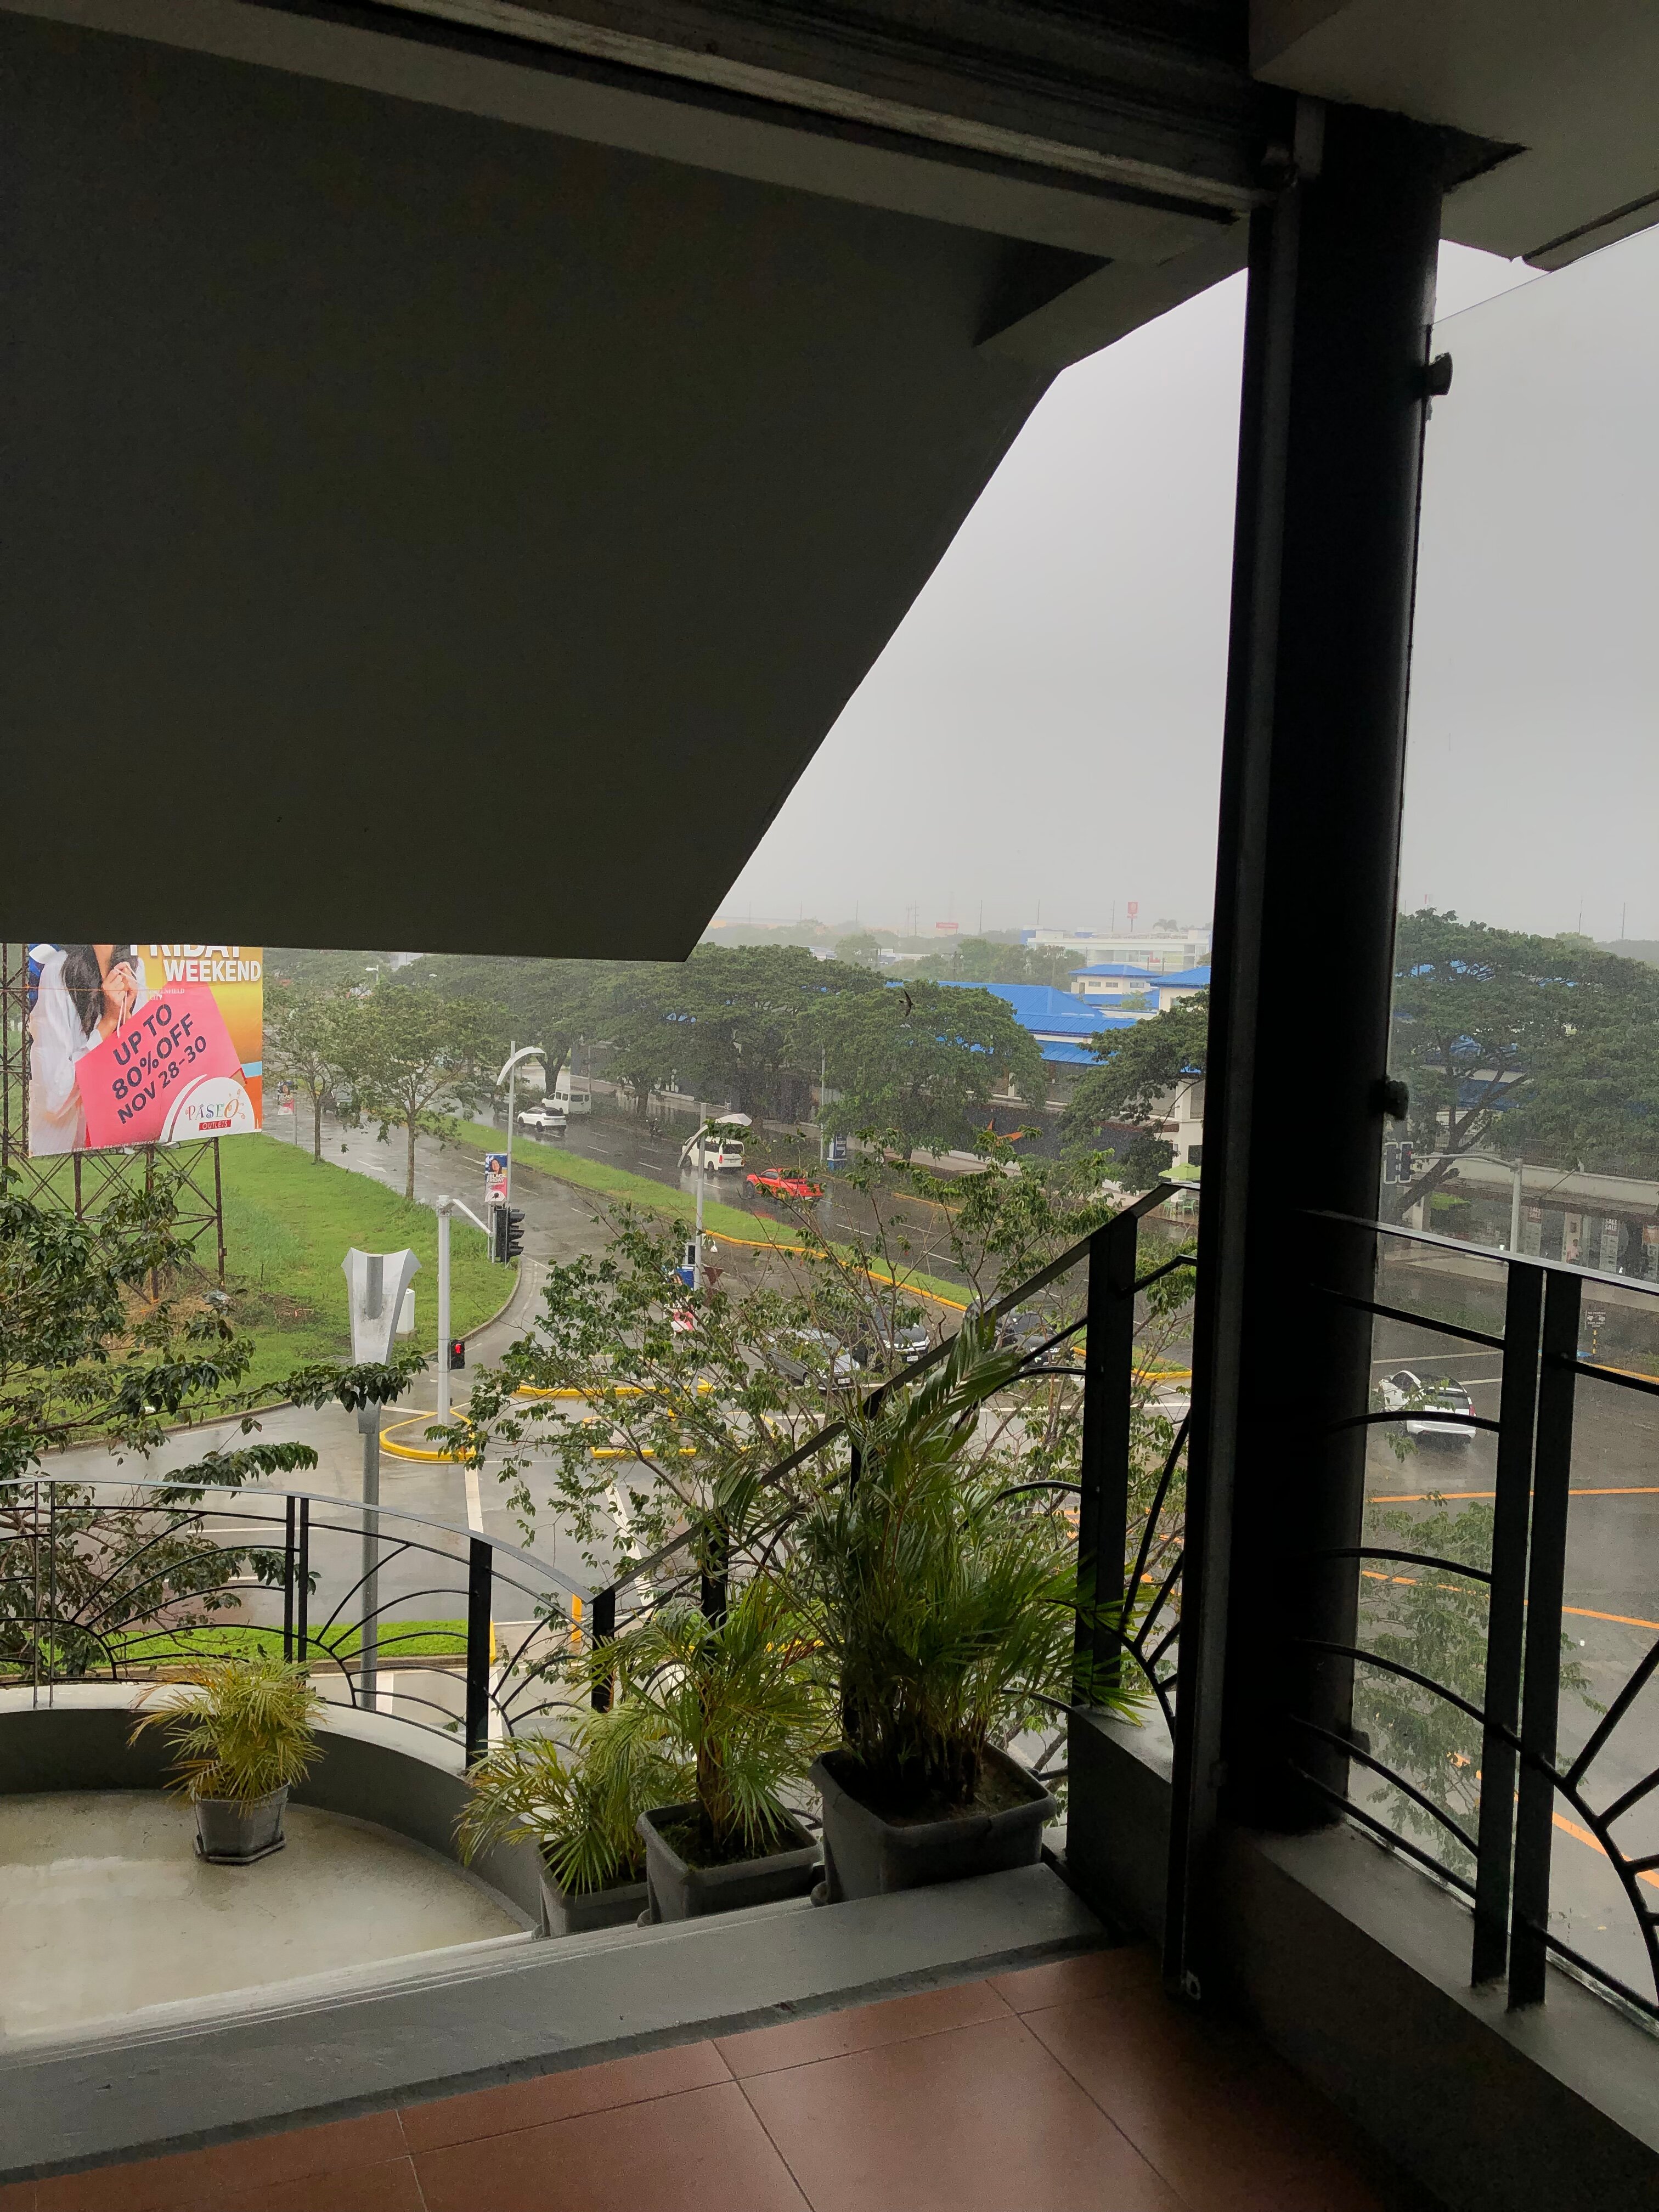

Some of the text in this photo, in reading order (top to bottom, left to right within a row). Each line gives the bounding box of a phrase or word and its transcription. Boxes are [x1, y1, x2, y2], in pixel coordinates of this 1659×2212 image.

[163, 959, 261, 982] WEEKEND
[113, 1003, 172, 1065] UP TO
[117, 1036, 206, 1125] NOV 28-30
[185, 1098, 240, 1121] PASEO
[201, 1119, 229, 1130] OUTLETS
